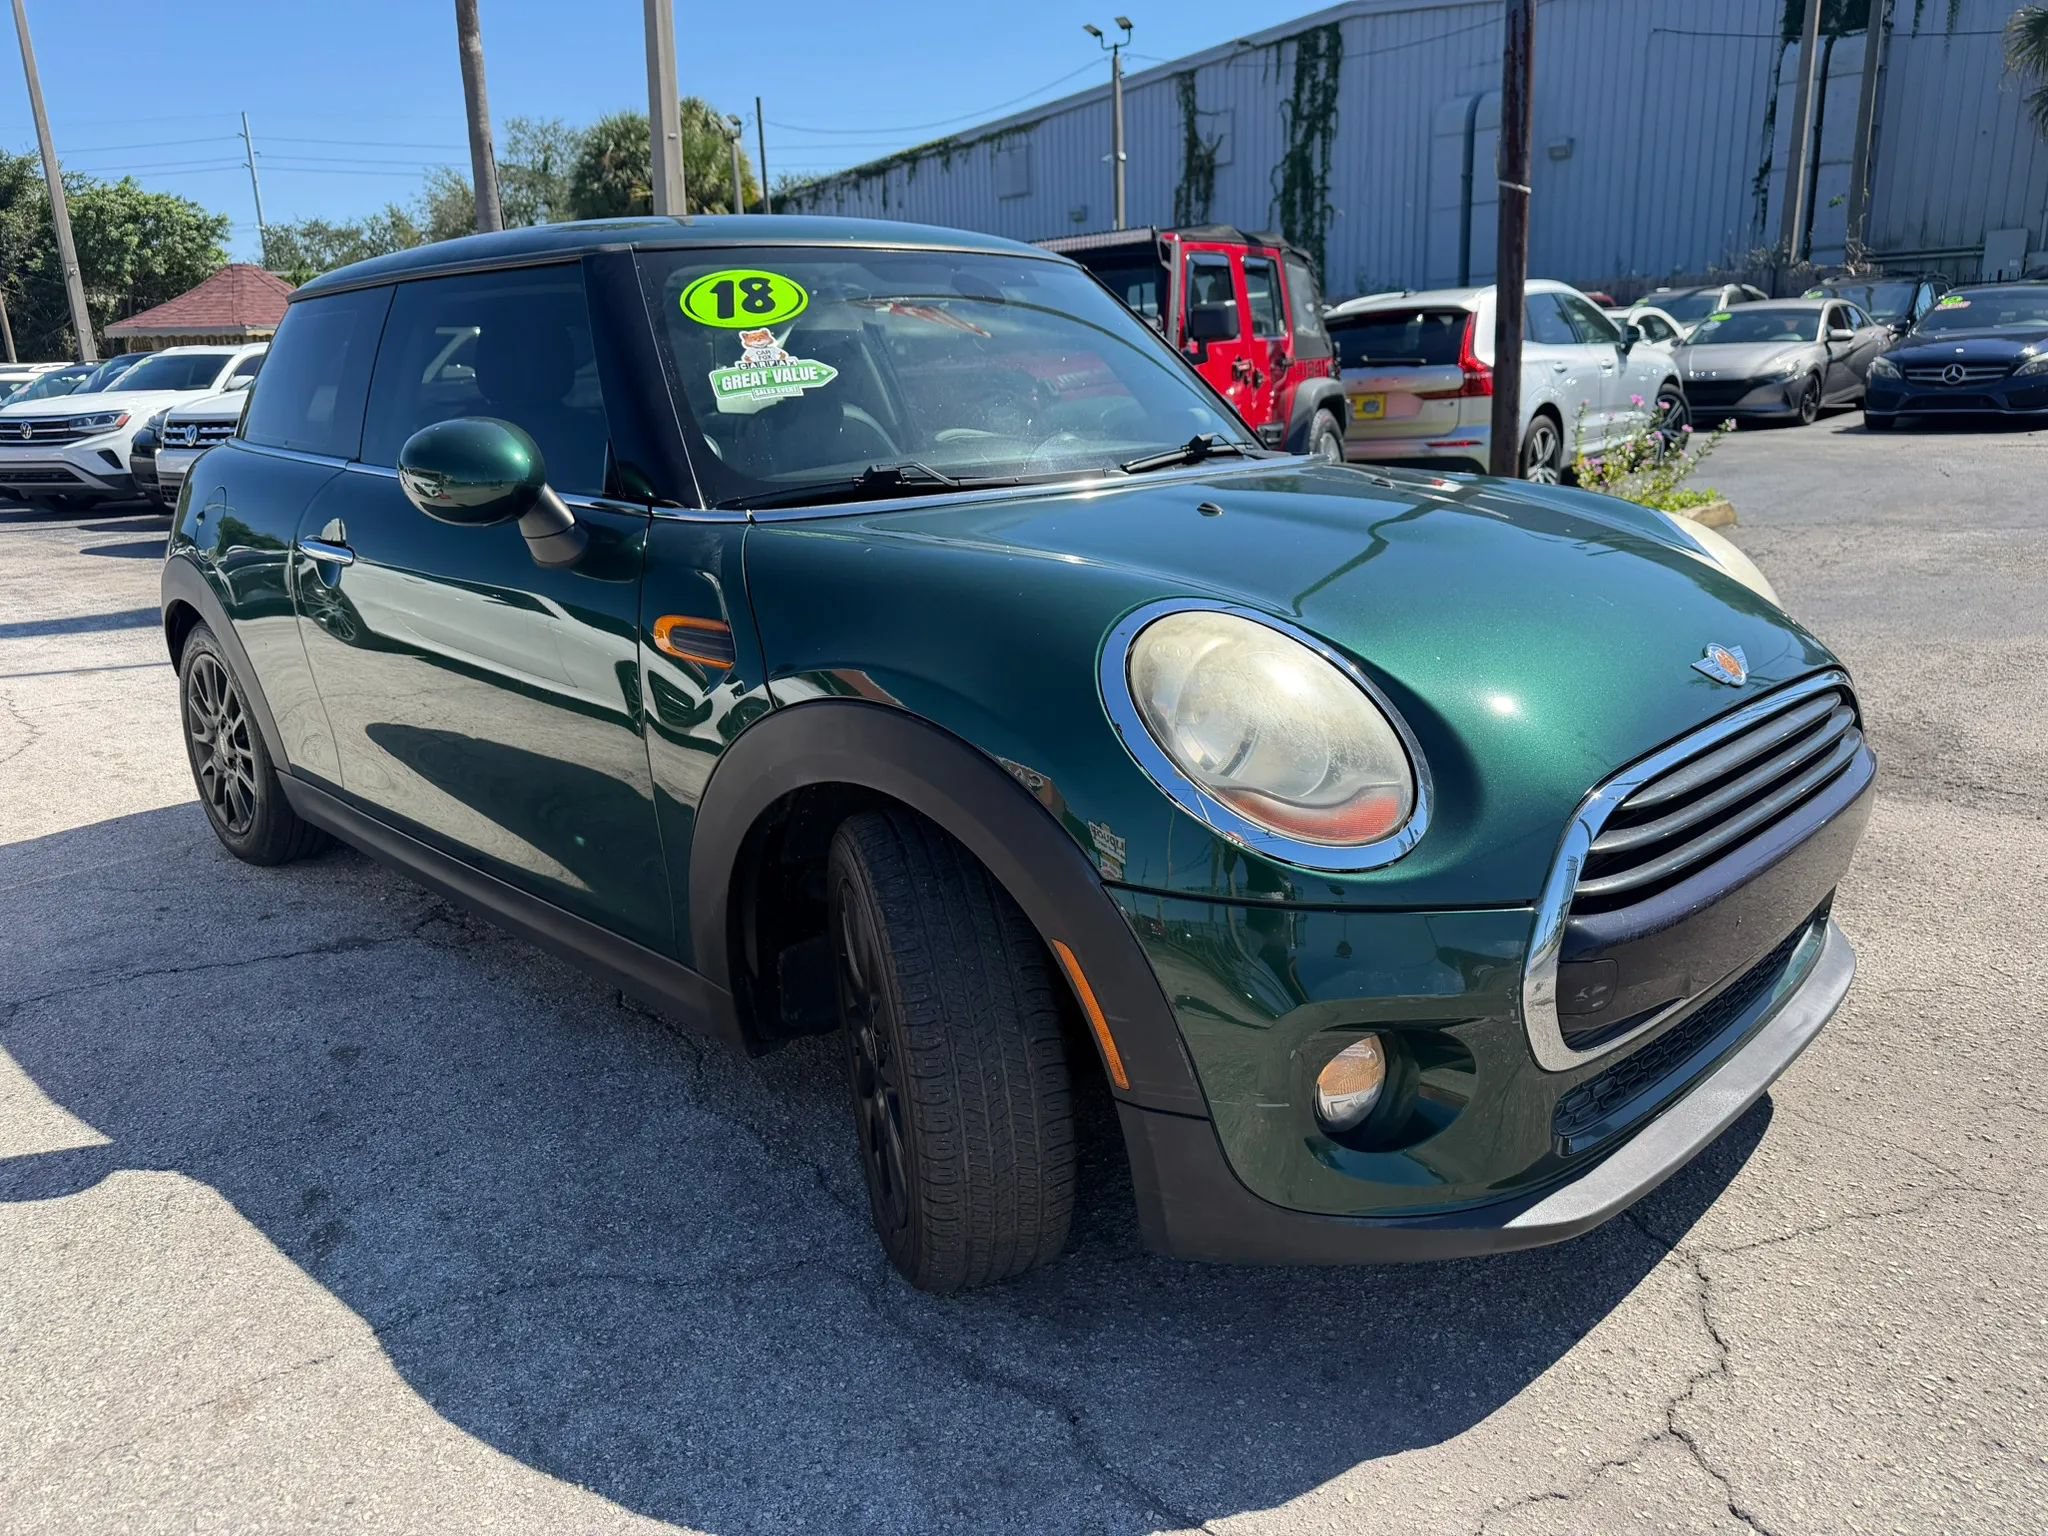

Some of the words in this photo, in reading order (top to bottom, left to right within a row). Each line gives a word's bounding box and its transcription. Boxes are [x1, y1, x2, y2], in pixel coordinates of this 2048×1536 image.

[709, 277, 776, 319] 18
[721, 370, 768, 391] GREAT
[772, 366, 818, 384] VALUE
